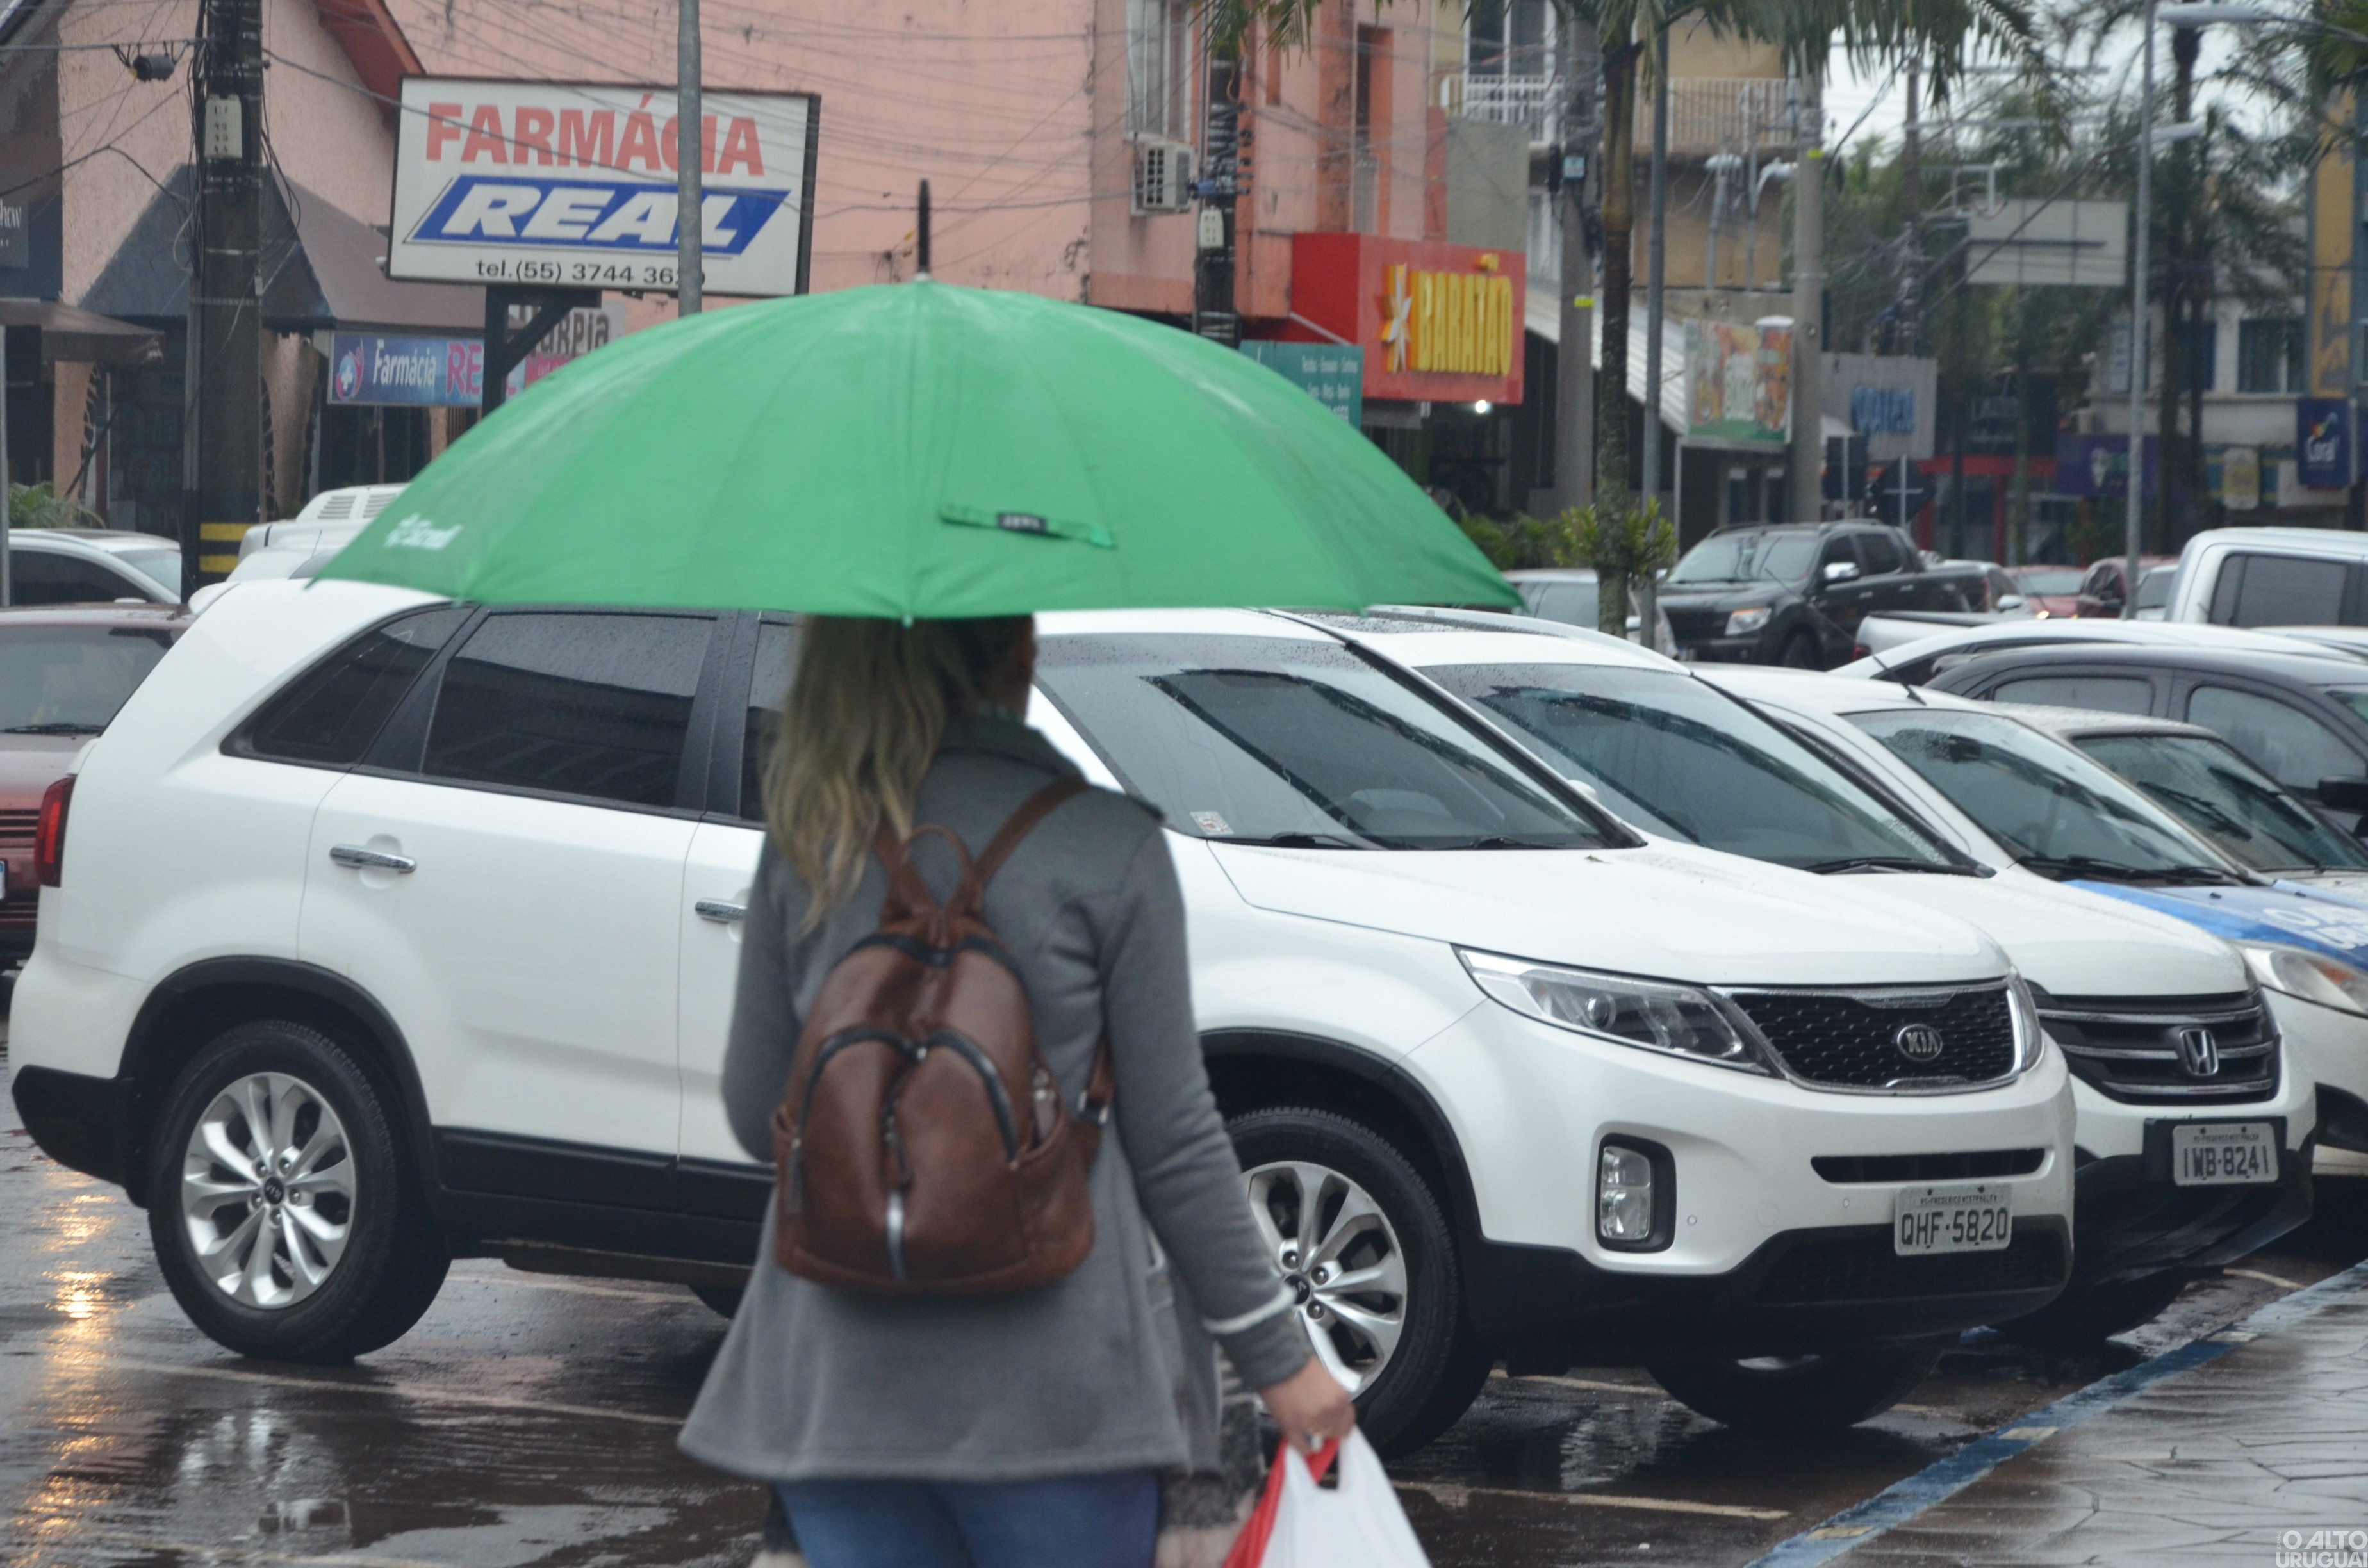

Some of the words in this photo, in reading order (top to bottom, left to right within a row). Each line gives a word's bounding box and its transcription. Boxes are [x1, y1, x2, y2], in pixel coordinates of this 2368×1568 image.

[441, 183, 737, 248] REAL
[571, 263, 634, 282] 3744
[643, 266, 705, 286] 36
[372, 339, 436, 387] Farmácia
[1905, 1031, 1939, 1053] KIA
